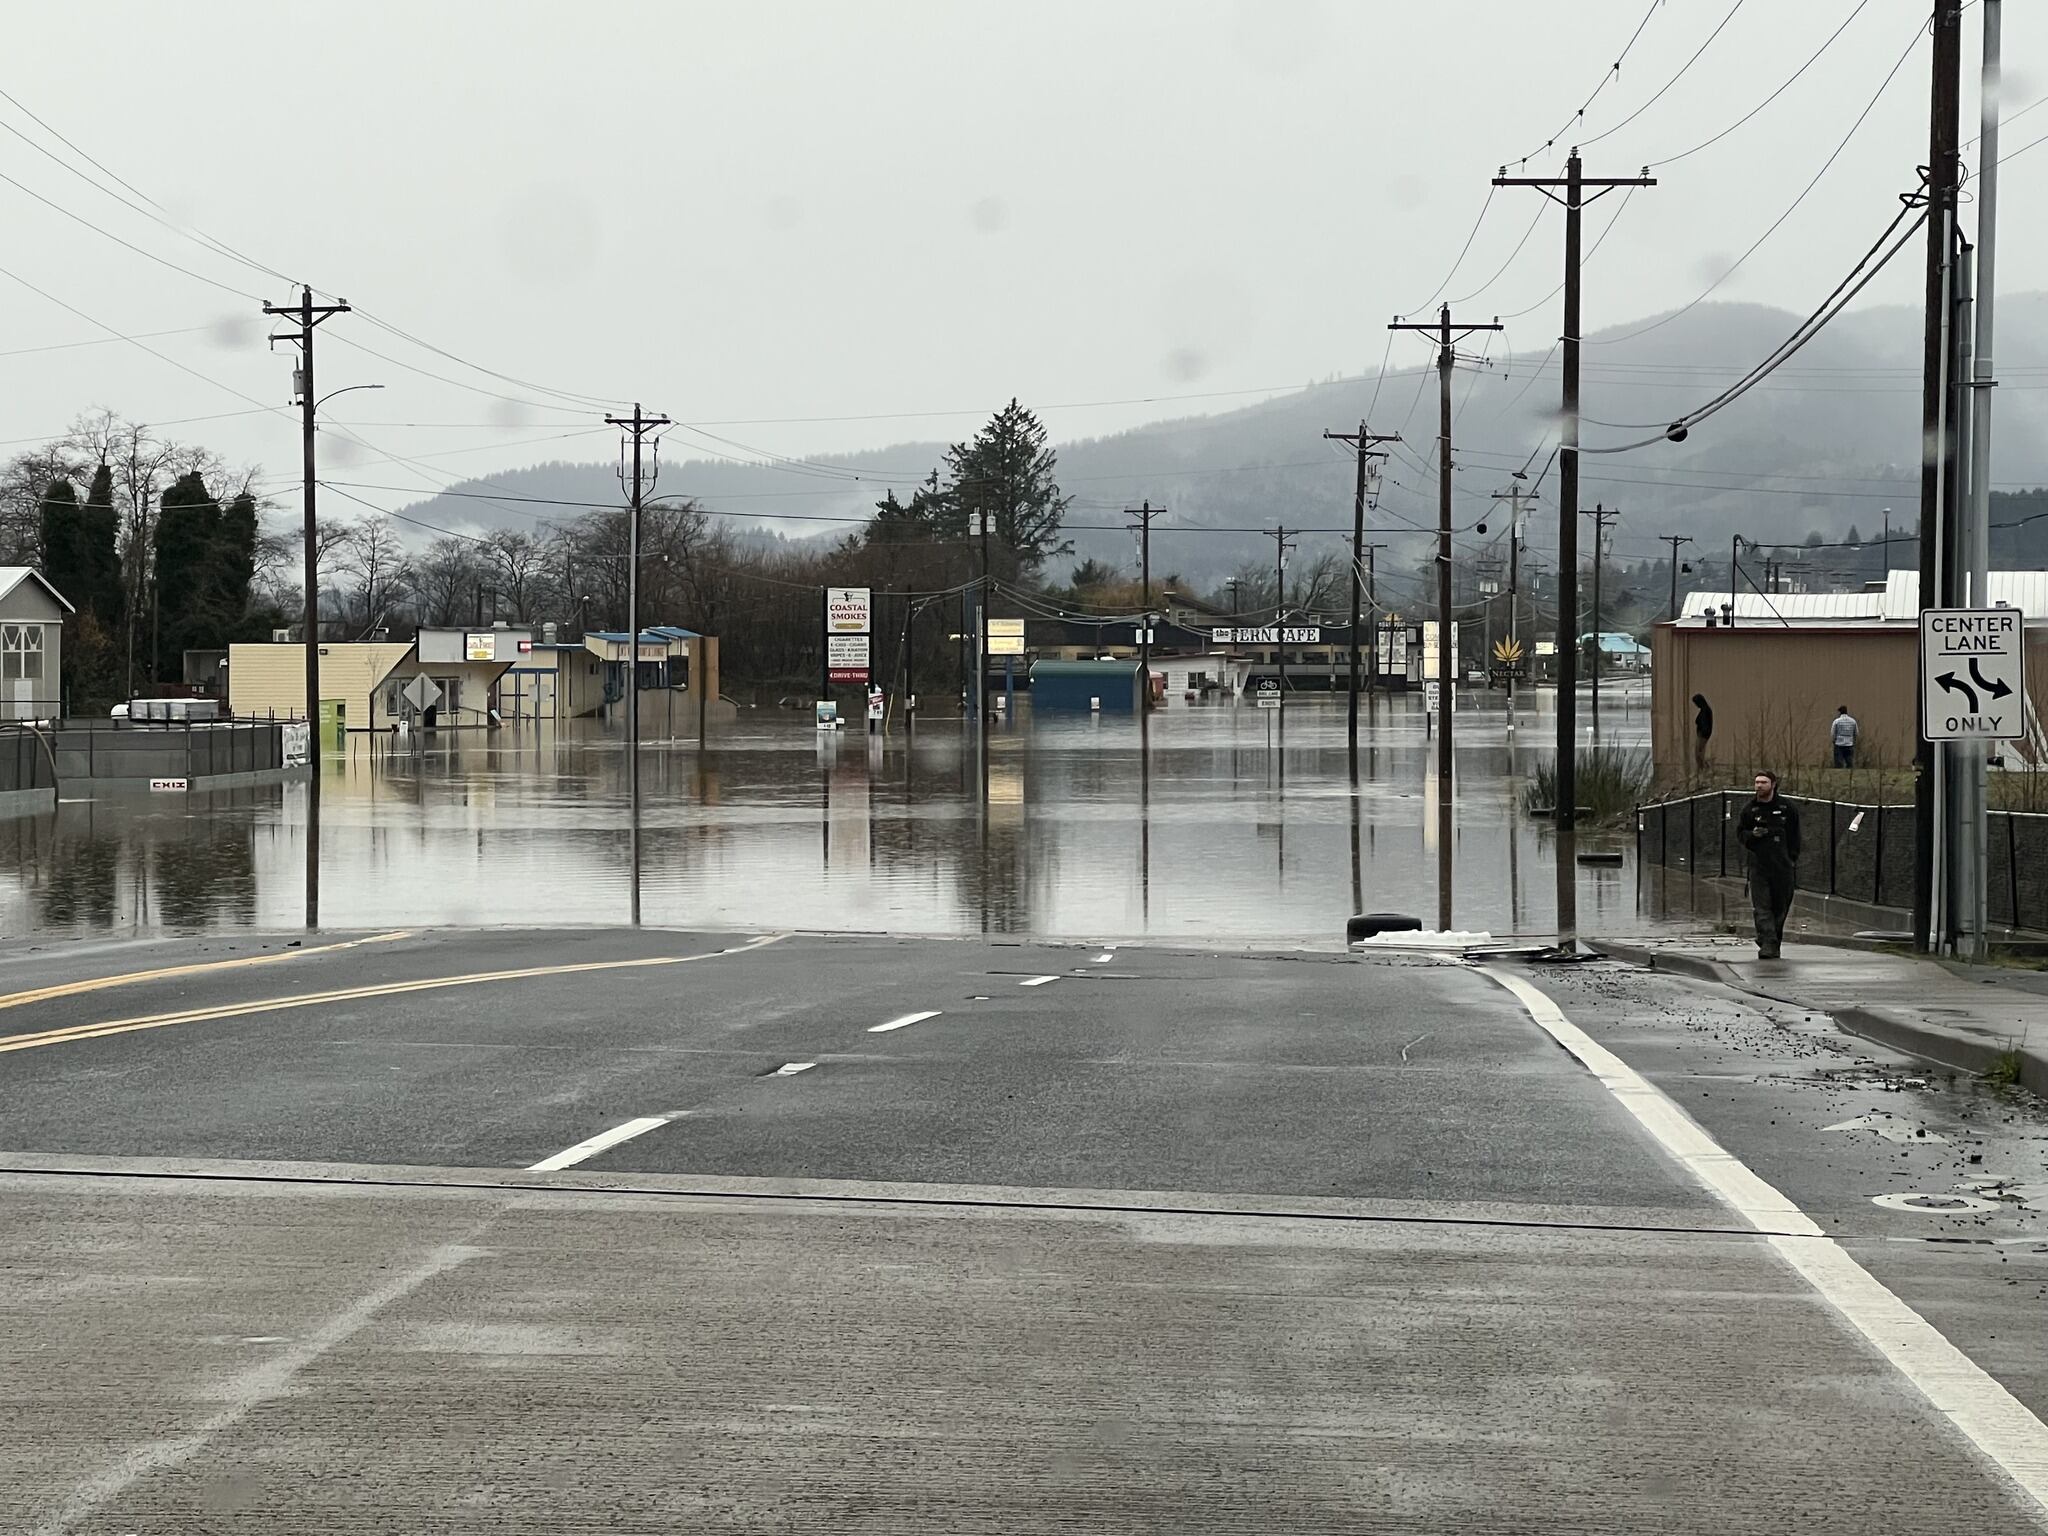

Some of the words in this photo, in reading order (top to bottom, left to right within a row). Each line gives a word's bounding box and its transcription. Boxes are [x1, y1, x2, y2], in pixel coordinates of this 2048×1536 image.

[1931, 617, 2013, 633] CENTER
[1216, 629, 1229, 637] the
[1277, 629, 1316, 641] AFE
[1945, 635, 2001, 650] LANE
[1945, 716, 2003, 732] ONLY
